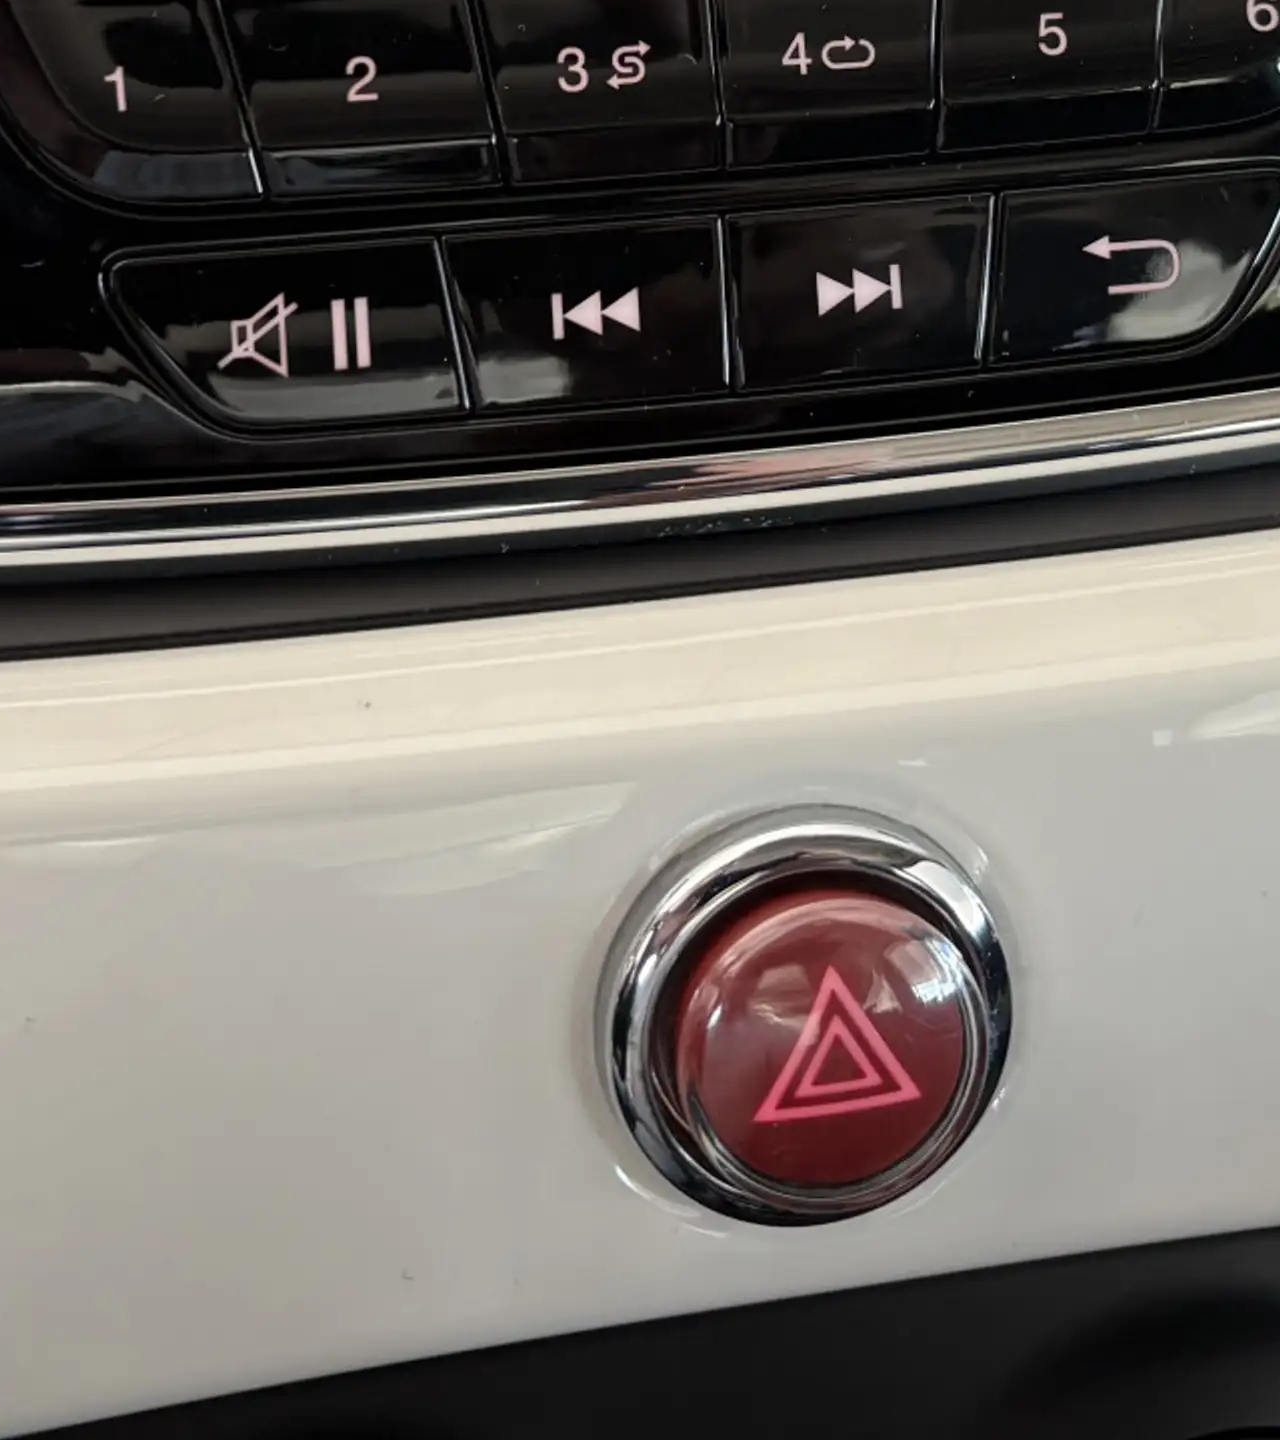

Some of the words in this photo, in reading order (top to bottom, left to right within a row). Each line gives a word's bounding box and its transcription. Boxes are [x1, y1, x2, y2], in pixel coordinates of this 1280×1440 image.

[781, 32, 813, 75] 4
[1038, 12, 1068, 56] 5
[104, 66, 127, 112] 1
[346, 56, 379, 102] 2
[557, 47, 589, 93] 3
